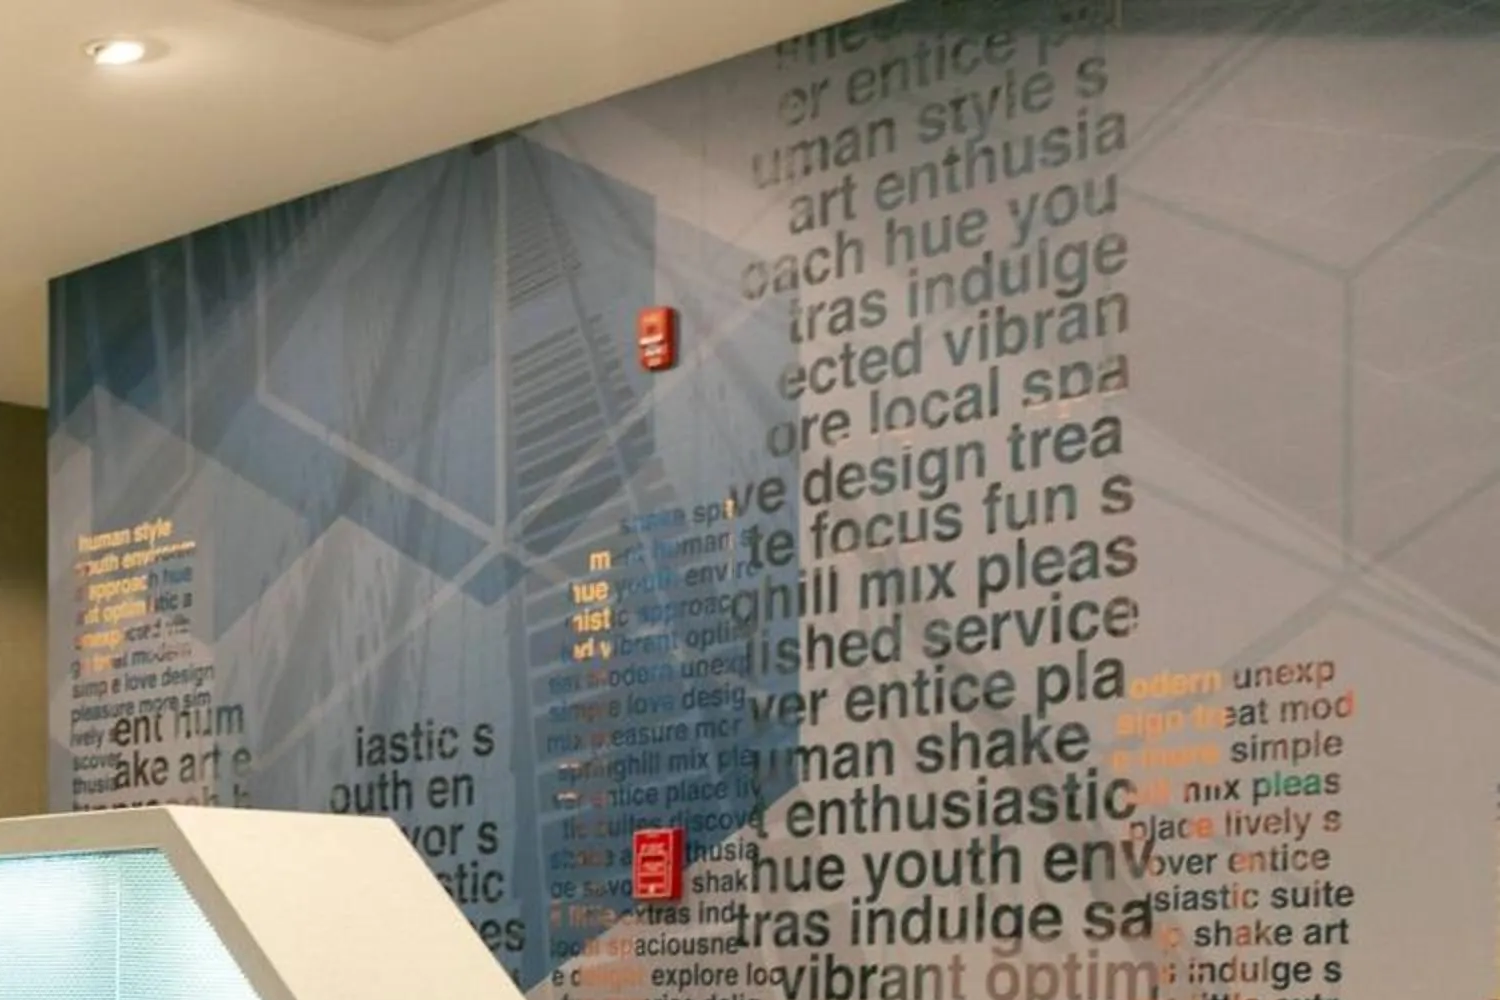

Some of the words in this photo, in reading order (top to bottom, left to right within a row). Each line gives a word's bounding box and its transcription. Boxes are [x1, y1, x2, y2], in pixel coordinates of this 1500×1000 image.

[847, 27, 1016, 106] entice
[752, 117, 896, 190] uman
[918, 69, 1055, 144] style
[1076, 55, 1108, 98] s
[789, 174, 857, 237] art
[874, 106, 1126, 213] enthusia
[741, 230, 864, 301] oach
[884, 207, 989, 266] hue
[1006, 173, 1118, 250] you
[790, 287, 888, 346] tras
[907, 231, 1129, 319] indulge
[779, 325, 923, 401] ected
[942, 291, 1130, 368] vibran
[767, 406, 851, 458] ore
[870, 366, 999, 435] local
[1022, 352, 1130, 420] spa
[728, 475, 786, 518] ve
[802, 439, 986, 506] design
[1007, 414, 1122, 472] trea
[750, 523, 794, 570] te
[811, 501, 963, 560] focus
[984, 481, 1077, 535] fun
[1102, 473, 1135, 516] s
[860, 559, 957, 609] mix
[979, 534, 1138, 605] pleas
[922, 591, 1138, 660] service
[749, 688, 828, 731] ver
[845, 664, 1015, 723] entice
[1036, 649, 1125, 719] pla
[1233, 660, 1336, 691] unexp
[115, 711, 162, 746] ent
[1280, 688, 1355, 723] mod
[116, 750, 169, 789] ake
[180, 743, 220, 784] art
[233, 747, 251, 778] e
[356, 718, 459, 768] iastic
[473, 722, 495, 757] s
[669, 749, 710, 771] mix
[915, 713, 1090, 774] shake
[1230, 729, 1344, 768] simple
[330, 769, 412, 813] outh
[427, 773, 475, 809] en
[665, 780, 728, 810] place
[786, 769, 1138, 838] enthusiastic
[1253, 771, 1341, 806] pleas
[477, 820, 499, 855] s
[1225, 806, 1312, 842] lively
[692, 868, 749, 894] shak
[751, 853, 845, 894] hue
[863, 835, 1021, 901] youth
[1043, 838, 1156, 882] env
[1147, 852, 1218, 877] over
[1228, 844, 1331, 874] entice
[1270, 880, 1355, 908] suite
[734, 902, 829, 948] tras
[851, 894, 1063, 958] indulge
[1084, 899, 1154, 942] sa
[1194, 919, 1292, 947] shake
[1304, 918, 1349, 945] art
[652, 963, 740, 993] explore
[1188, 955, 1312, 991] indulge
[1324, 960, 1342, 983] s
